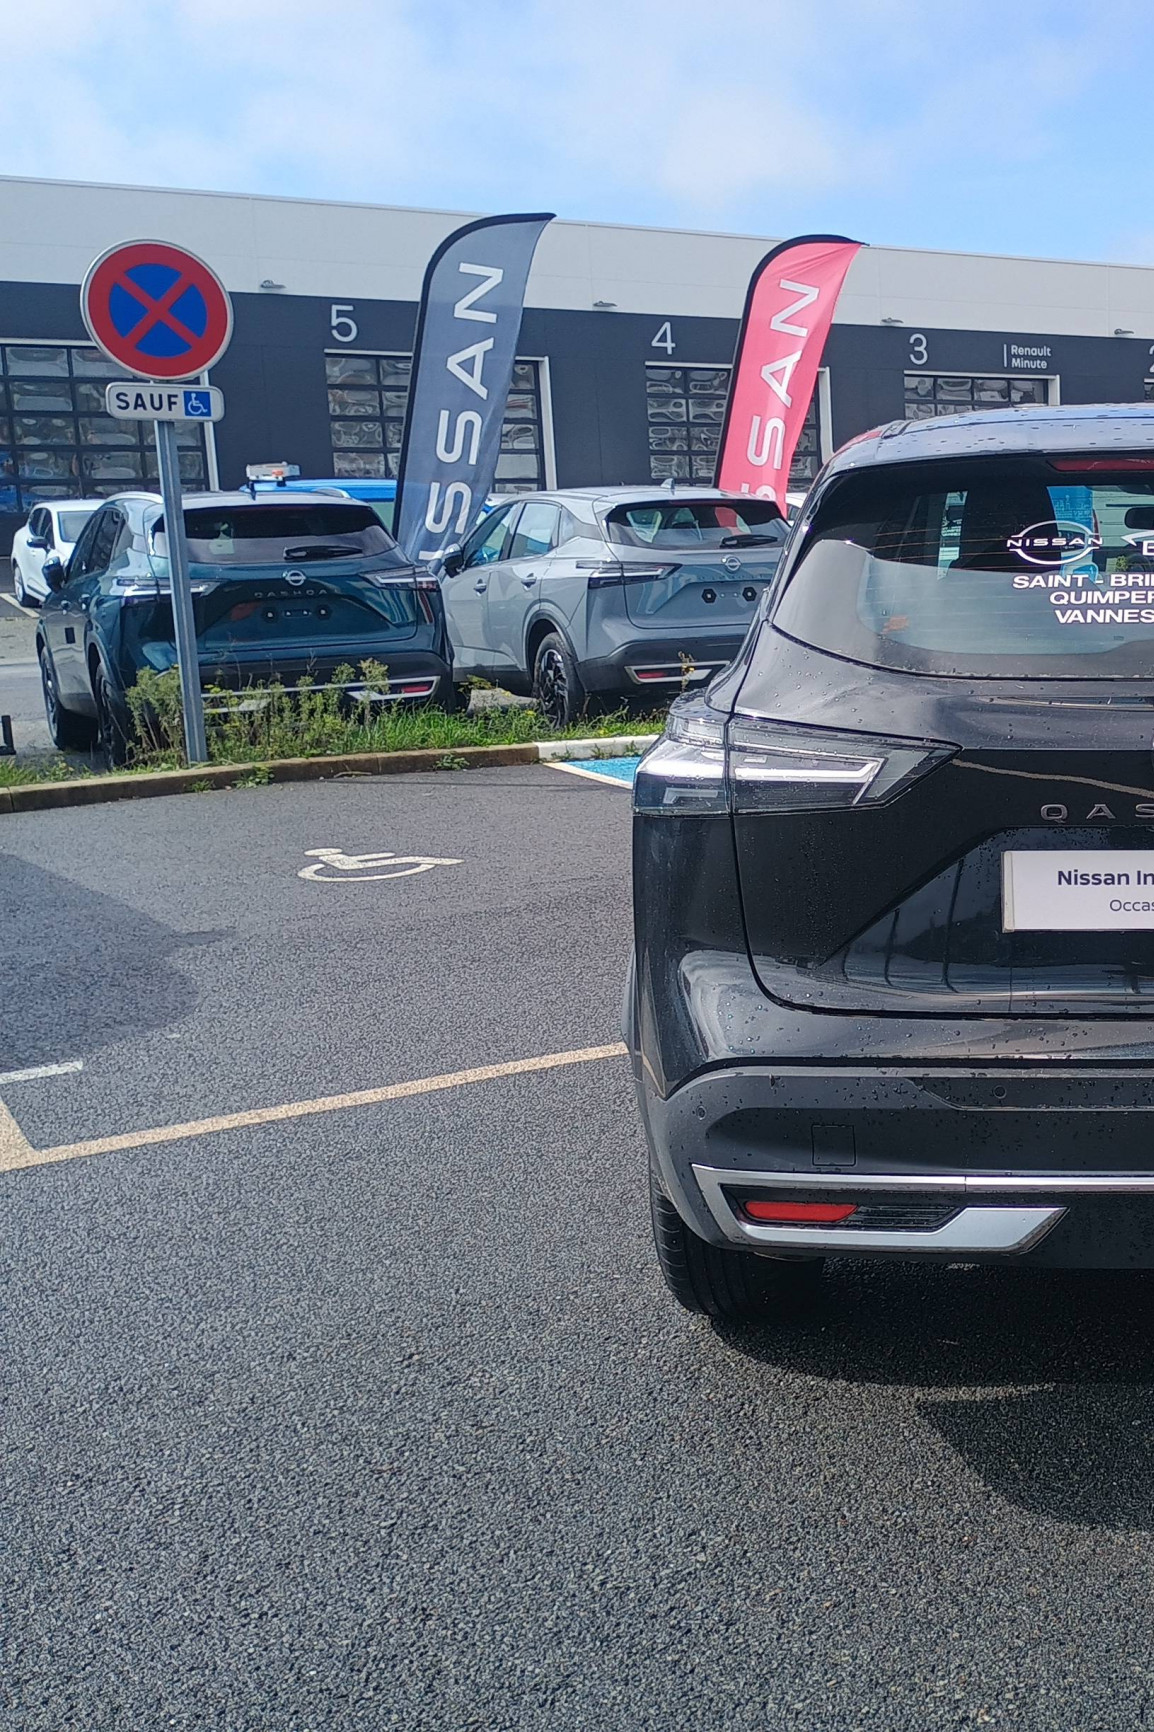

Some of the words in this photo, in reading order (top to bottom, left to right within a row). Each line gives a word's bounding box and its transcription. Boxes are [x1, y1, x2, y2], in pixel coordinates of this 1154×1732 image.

[331, 304, 357, 342] 5
[651, 321, 676, 355] 4
[908, 333, 928, 365] 3
[1011, 344, 1052, 357] Renault
[1011, 357, 1048, 369] Minute
[115, 392, 179, 411] SAUF
[1006, 537, 1103, 548] NISSAN
[1012, 574, 1089, 589] SAINT
[1057, 870, 1130, 886] Nissan
